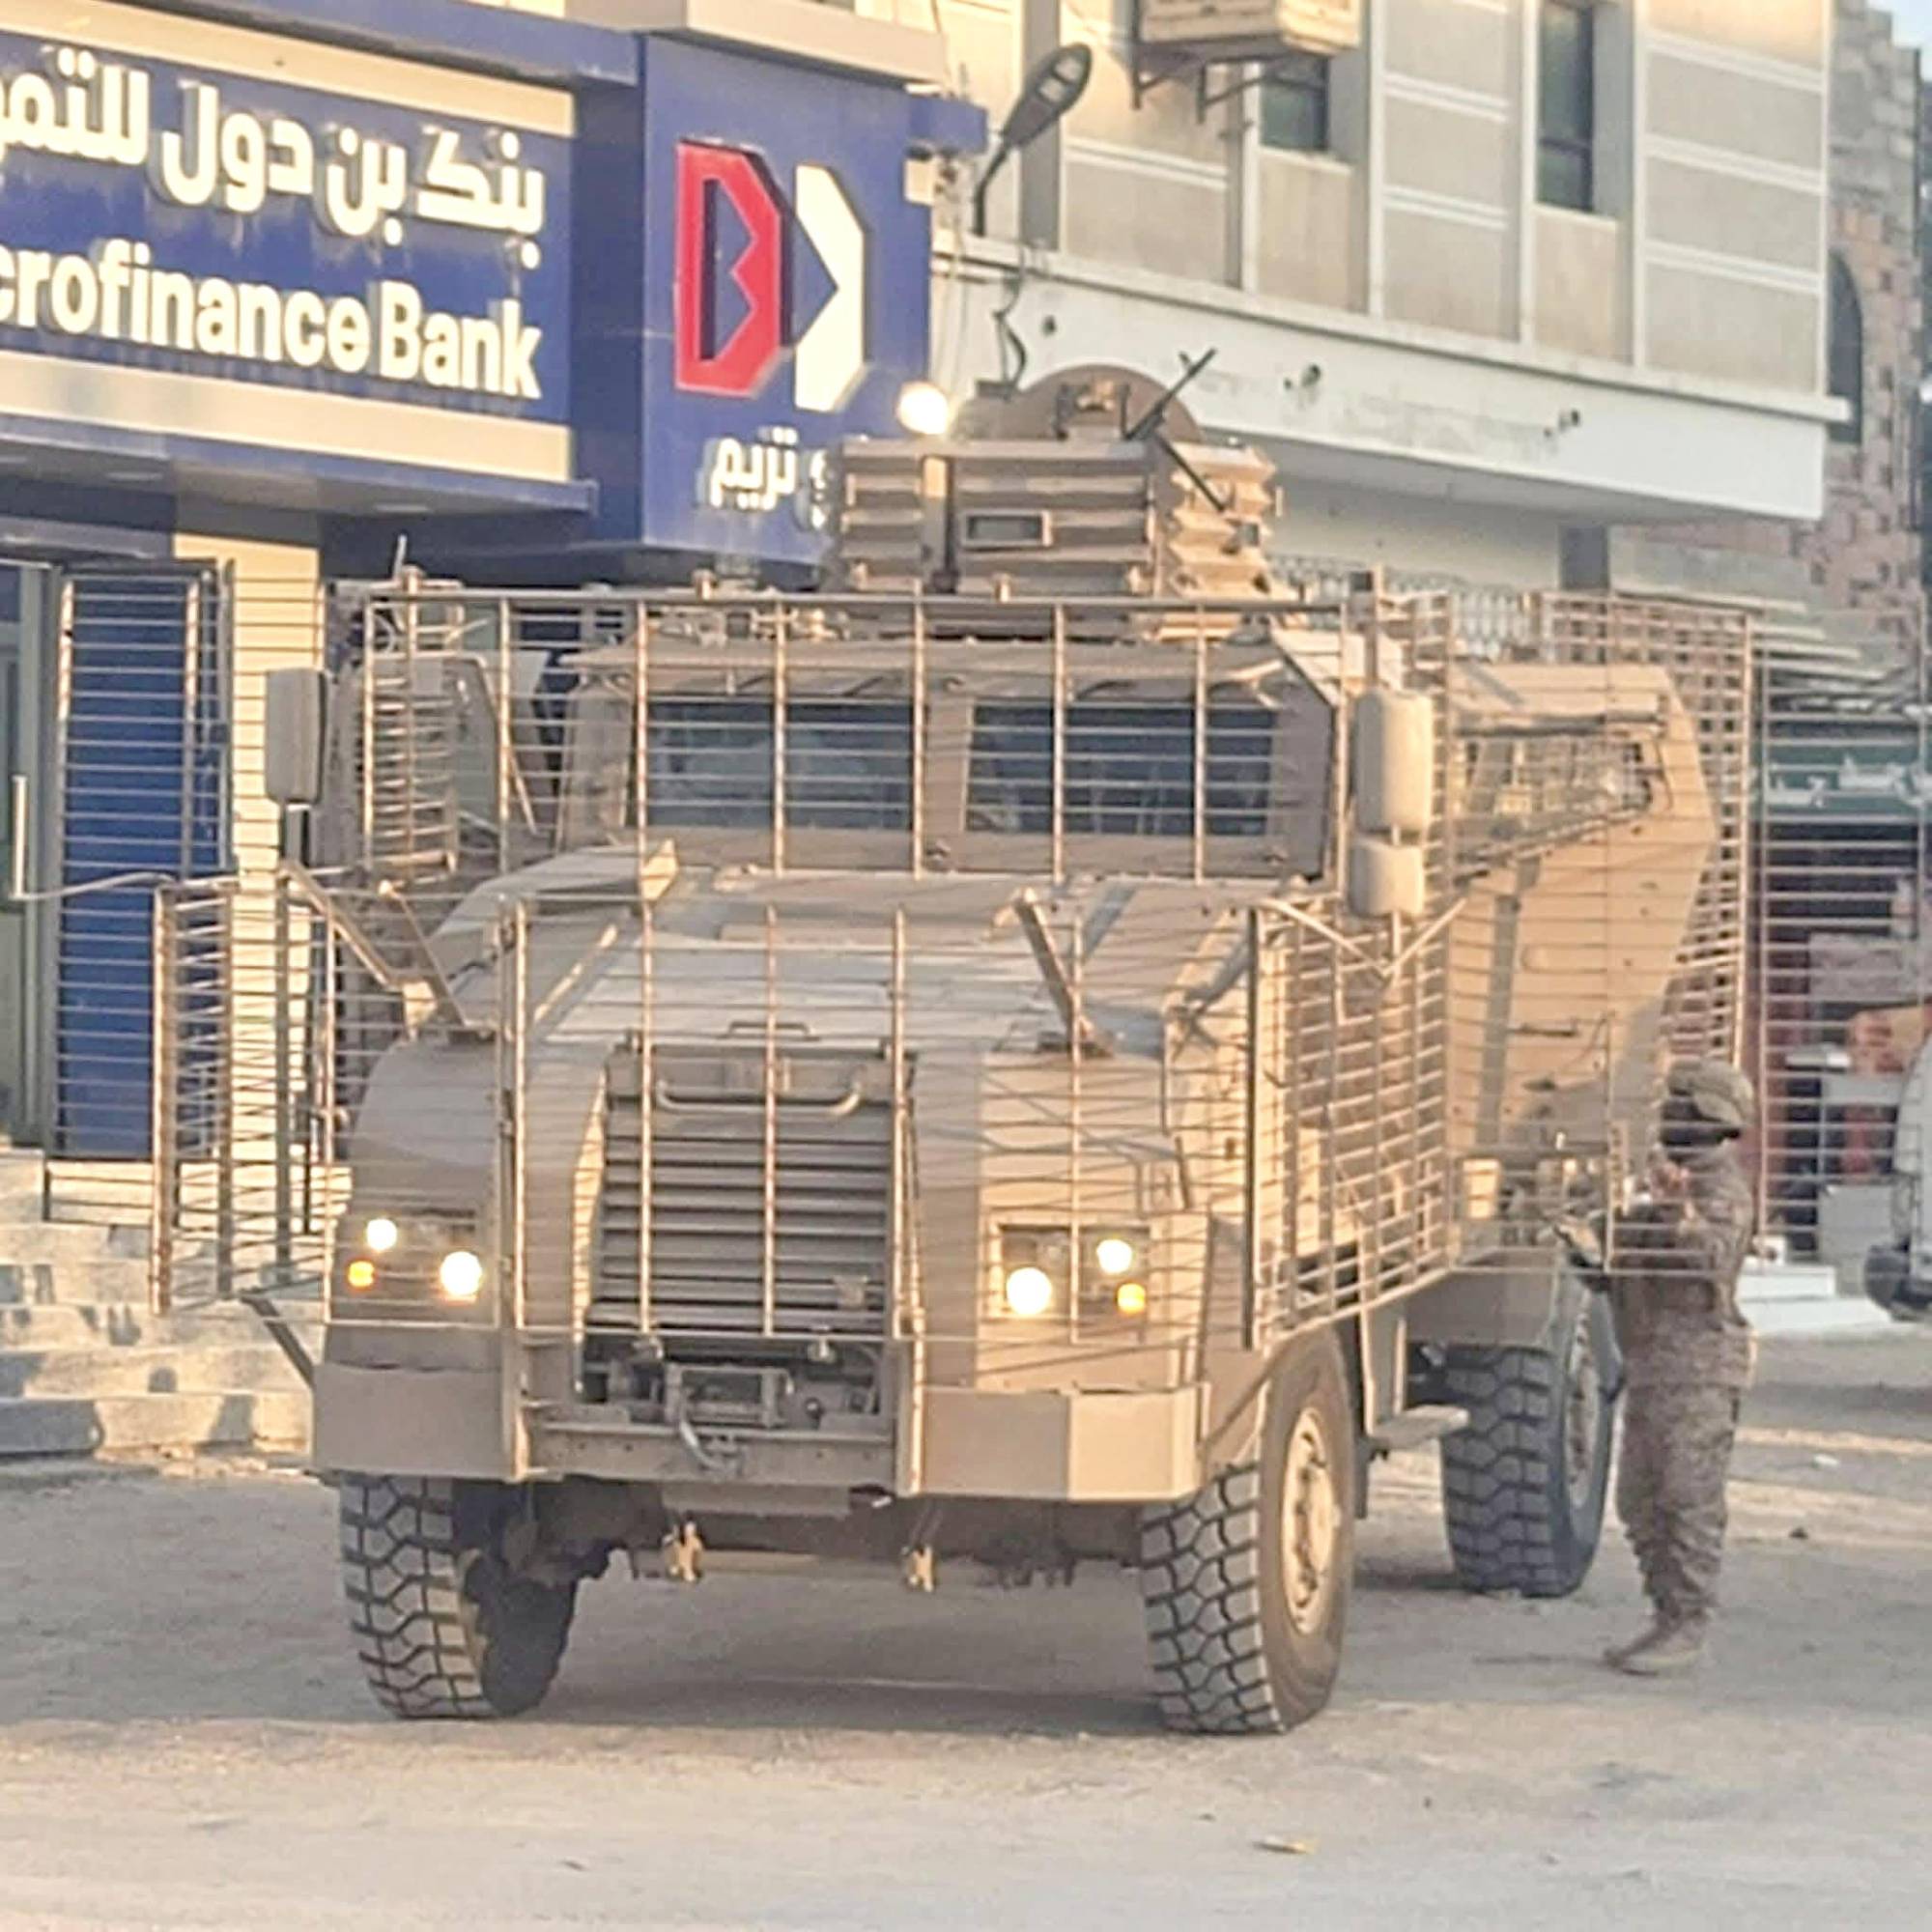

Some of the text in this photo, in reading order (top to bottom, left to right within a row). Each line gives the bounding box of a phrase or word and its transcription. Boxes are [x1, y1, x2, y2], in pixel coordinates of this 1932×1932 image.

[0, 46, 545, 270] بنك بن دول للتم
[379, 280, 543, 399] Bank
[709, 425, 799, 511] تريم
